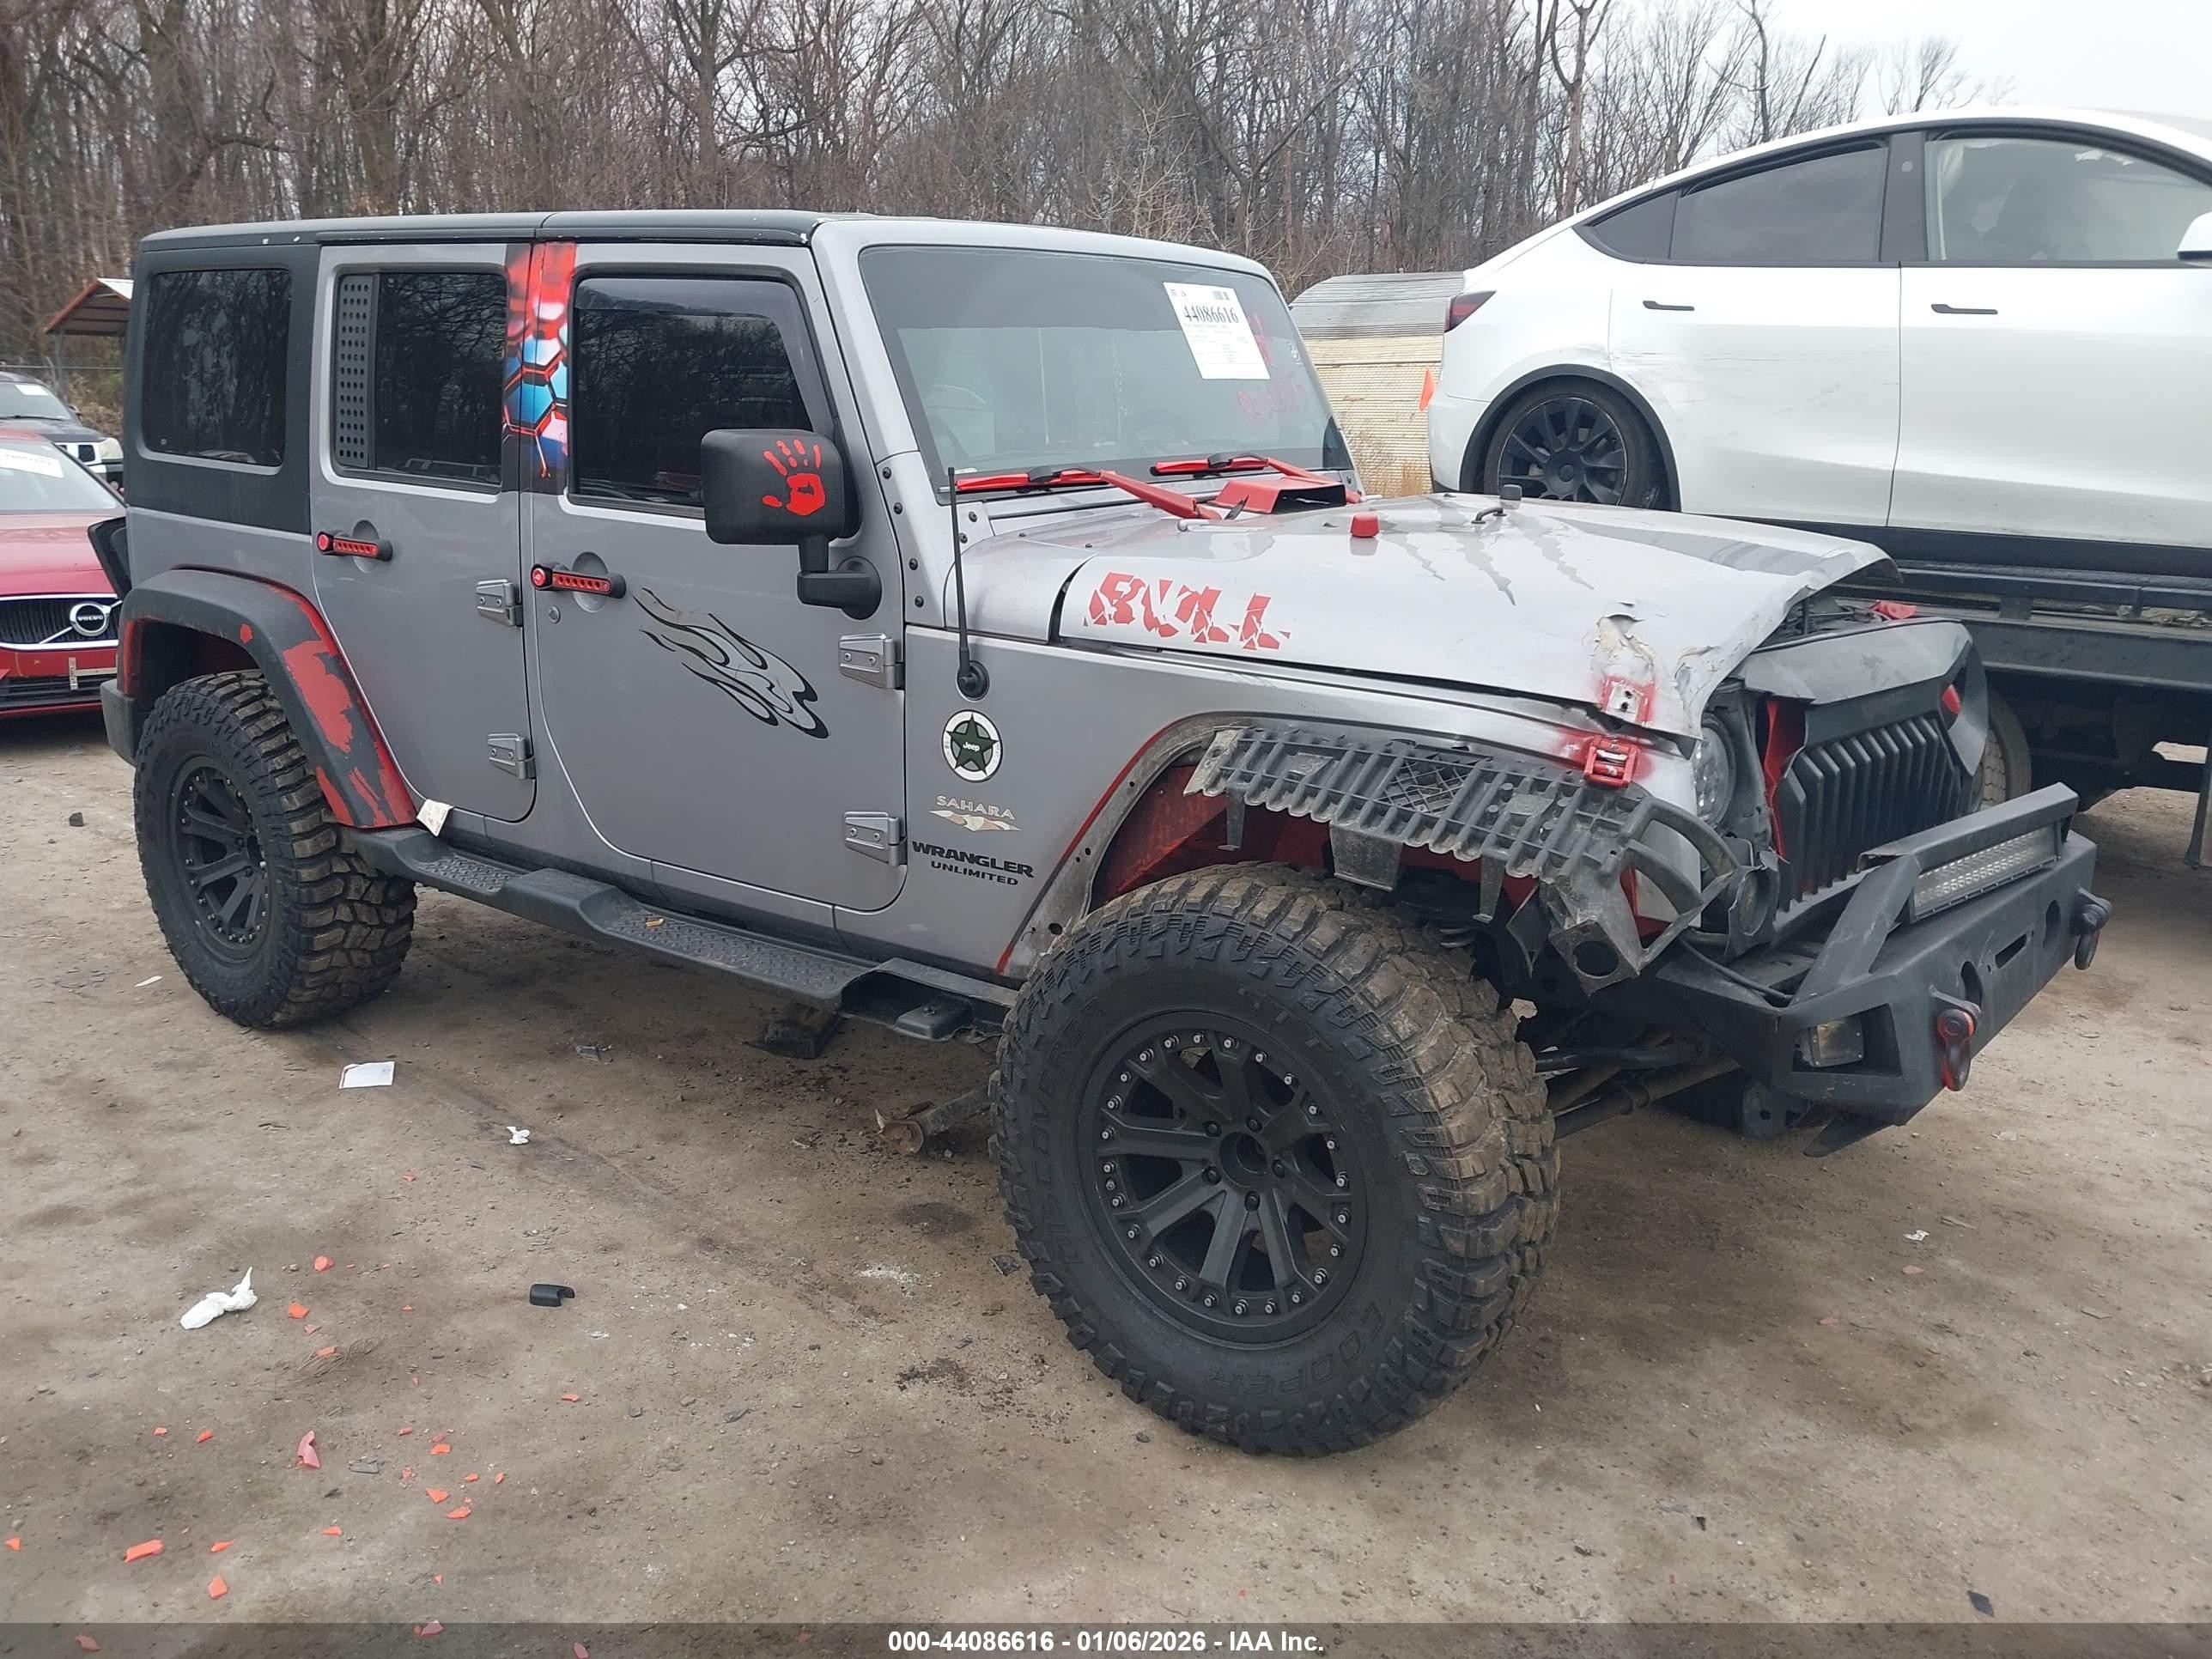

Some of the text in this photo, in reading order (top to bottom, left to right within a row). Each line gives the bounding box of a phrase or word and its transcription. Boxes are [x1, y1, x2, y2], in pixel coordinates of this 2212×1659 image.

[1183, 305, 1239, 324] 44086616
[963, 742, 980, 751] Jeep
[936, 795, 1016, 820] SAHARA
[912, 842, 1035, 878] WRANGLER
[931, 861, 1018, 885] UNLIMITED
[1209, 1301, 1384, 1396] COOPER
